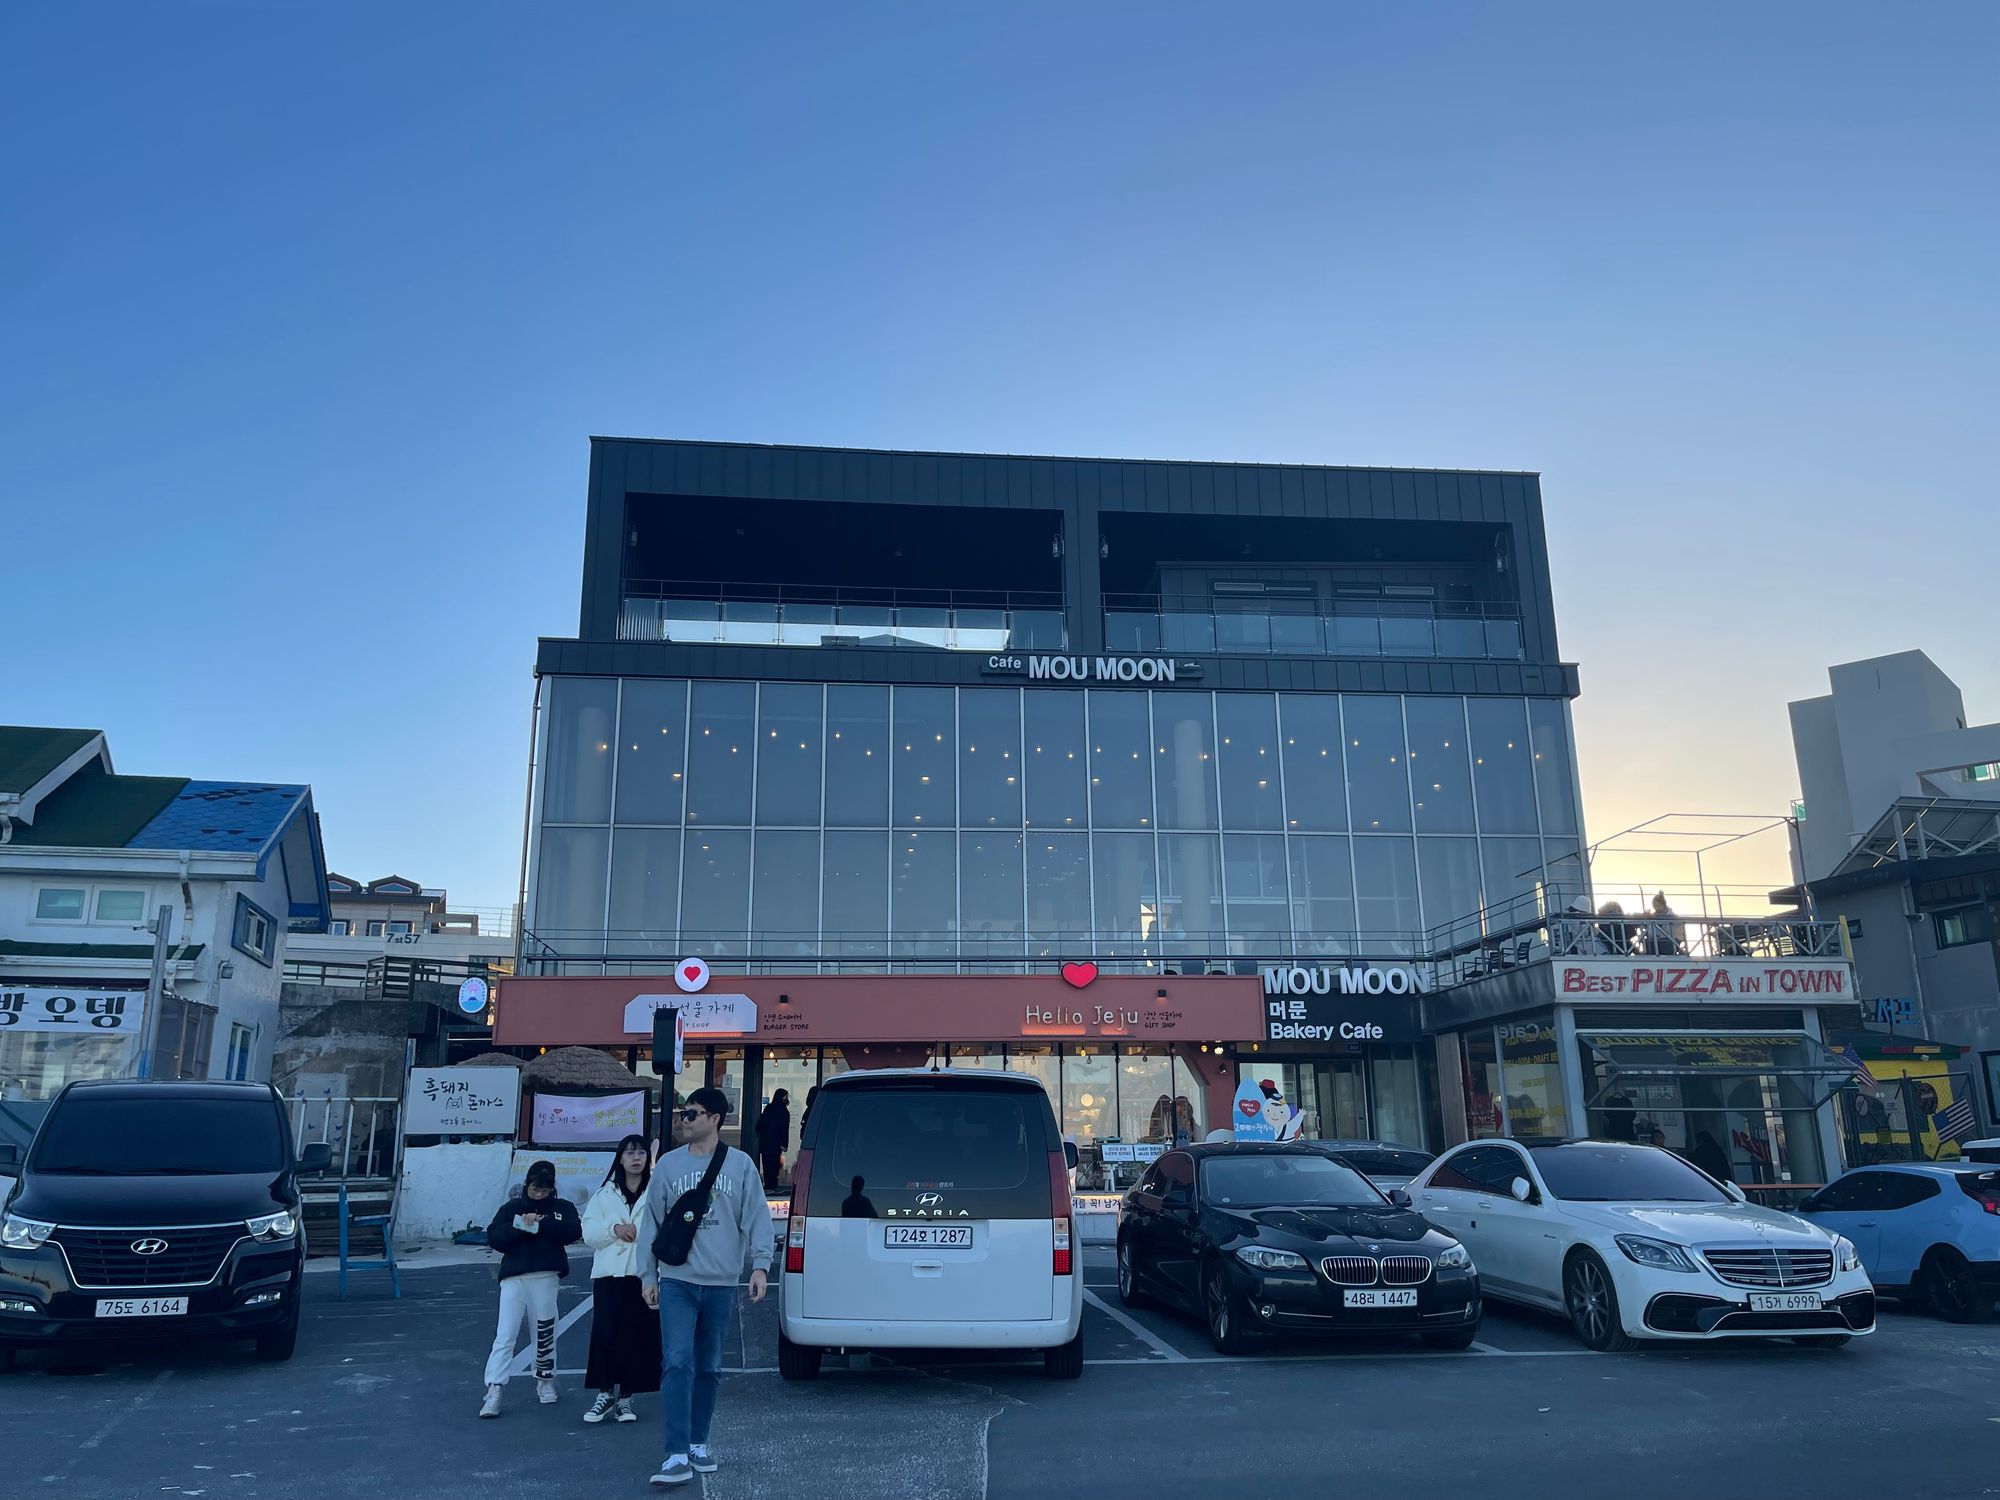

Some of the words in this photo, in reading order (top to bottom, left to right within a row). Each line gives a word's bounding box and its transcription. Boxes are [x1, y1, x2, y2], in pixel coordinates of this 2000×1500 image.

[988, 655, 1022, 669] Cafe
[1028, 655, 1089, 680] MOU
[1095, 657, 1176, 682] MOON
[1263, 967, 1331, 995] MOU
[1339, 967, 1431, 995] MOON
[1563, 967, 1629, 993] BEST
[1631, 968, 1733, 993] PIZZA
[1739, 977, 1761, 993] IN
[1763, 968, 1843, 993] TOWN
[38, 996, 126, 1028] 오뎅
[1092, 1005, 1139, 1031] Jeju
[1269, 1000, 1307, 1020] 머문
[790, 1023, 809, 1031] STORE
[1161, 1021, 1176, 1029] SHOP
[1270, 1022, 1334, 1041] Bakery
[1339, 1021, 1384, 1039] Cafe
[423, 1077, 470, 1102] 흑돼지
[467, 1094, 504, 1111] 돈까스
[887, 1208, 969, 1216] STARIA
[892, 1229, 927, 1243] 124호
[931, 1229, 966, 1243] 1287
[104, 1301, 134, 1315] 75도
[141, 1300, 180, 1314] 6164
[1380, 1292, 1411, 1305] 1447
[1787, 1295, 1815, 1309] 6999
